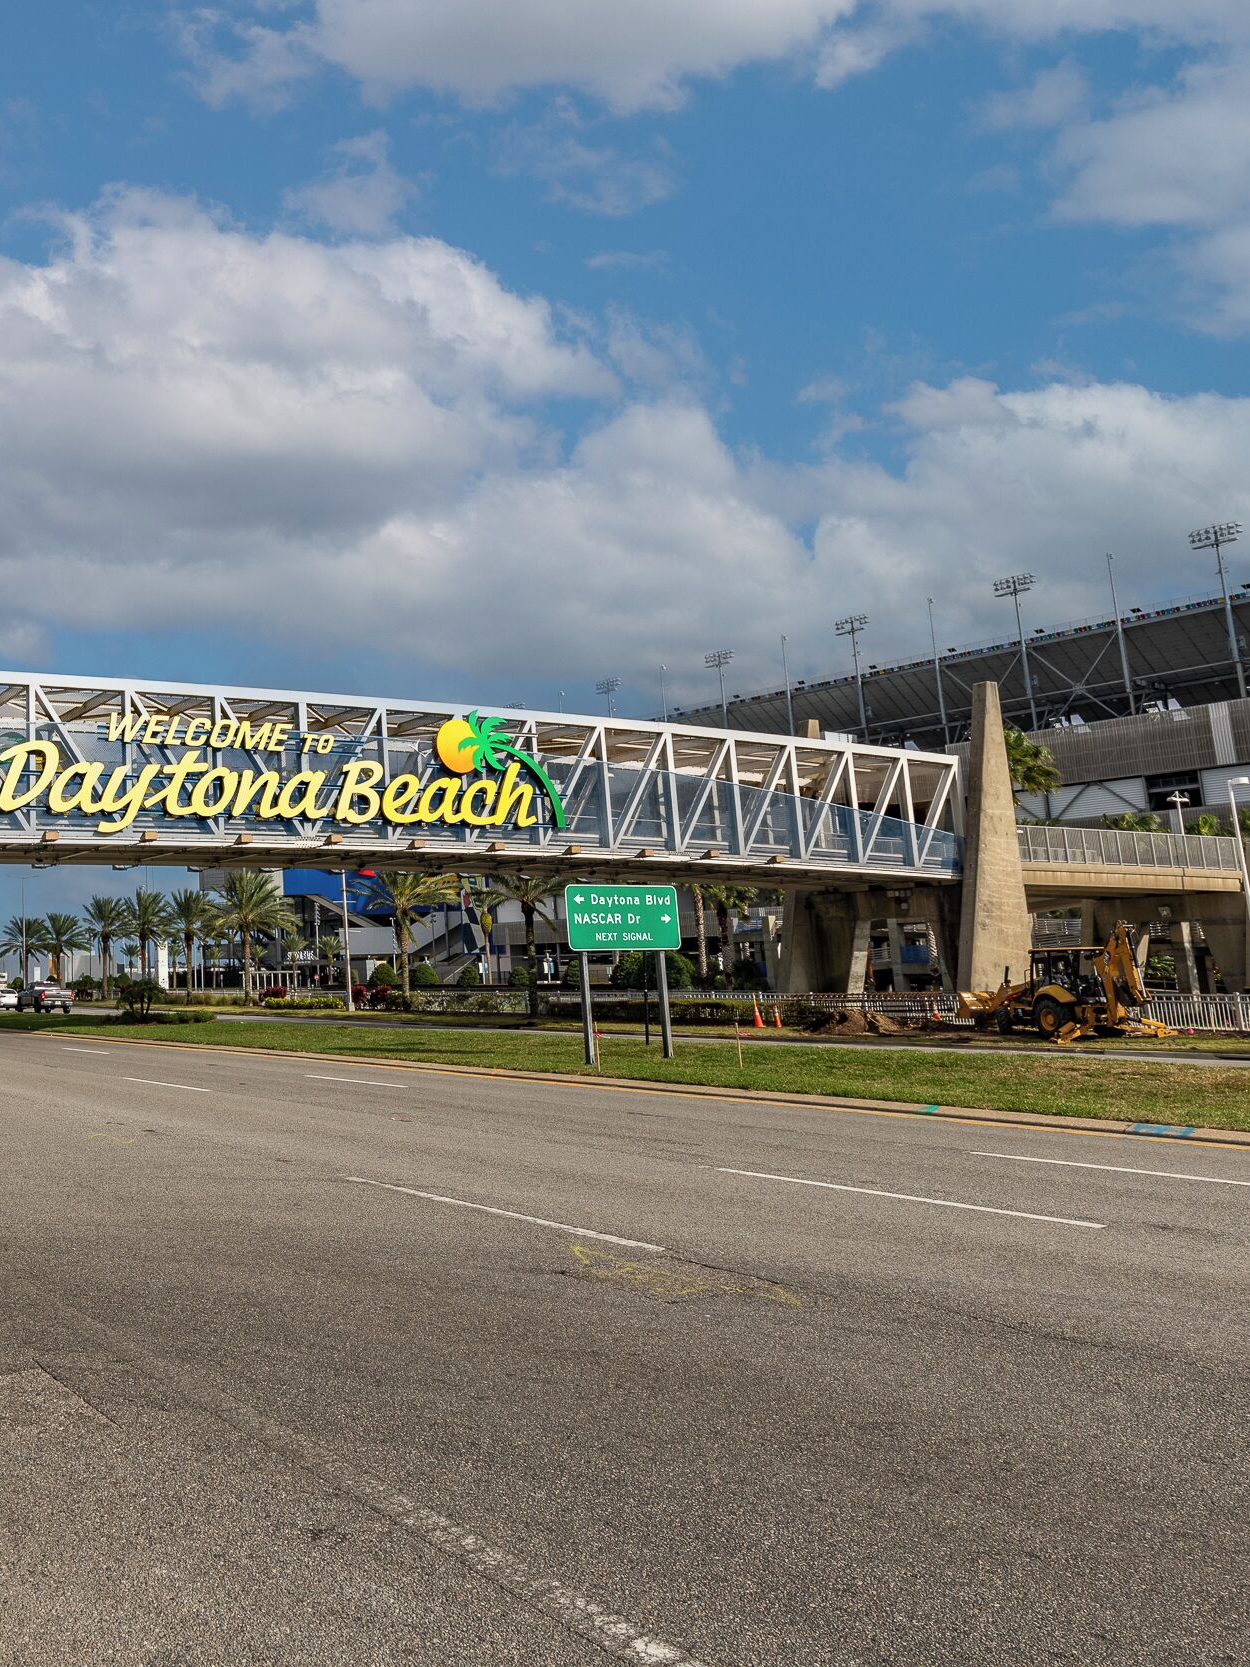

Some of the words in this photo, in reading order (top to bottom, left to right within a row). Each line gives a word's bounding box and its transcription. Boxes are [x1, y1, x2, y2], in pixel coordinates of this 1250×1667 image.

[107, 711, 294, 752] WELCOME
[302, 733, 335, 755] TO
[0, 740, 329, 834] Daytona
[335, 760, 538, 828] Beach
[590, 893, 640, 907] Daytona
[645, 894, 671, 905] Blvd
[573, 913, 622, 924] NASCAR
[627, 913, 641, 924] Dr
[595, 932, 618, 941] NEXT
[622, 932, 654, 941] SIGNAL
